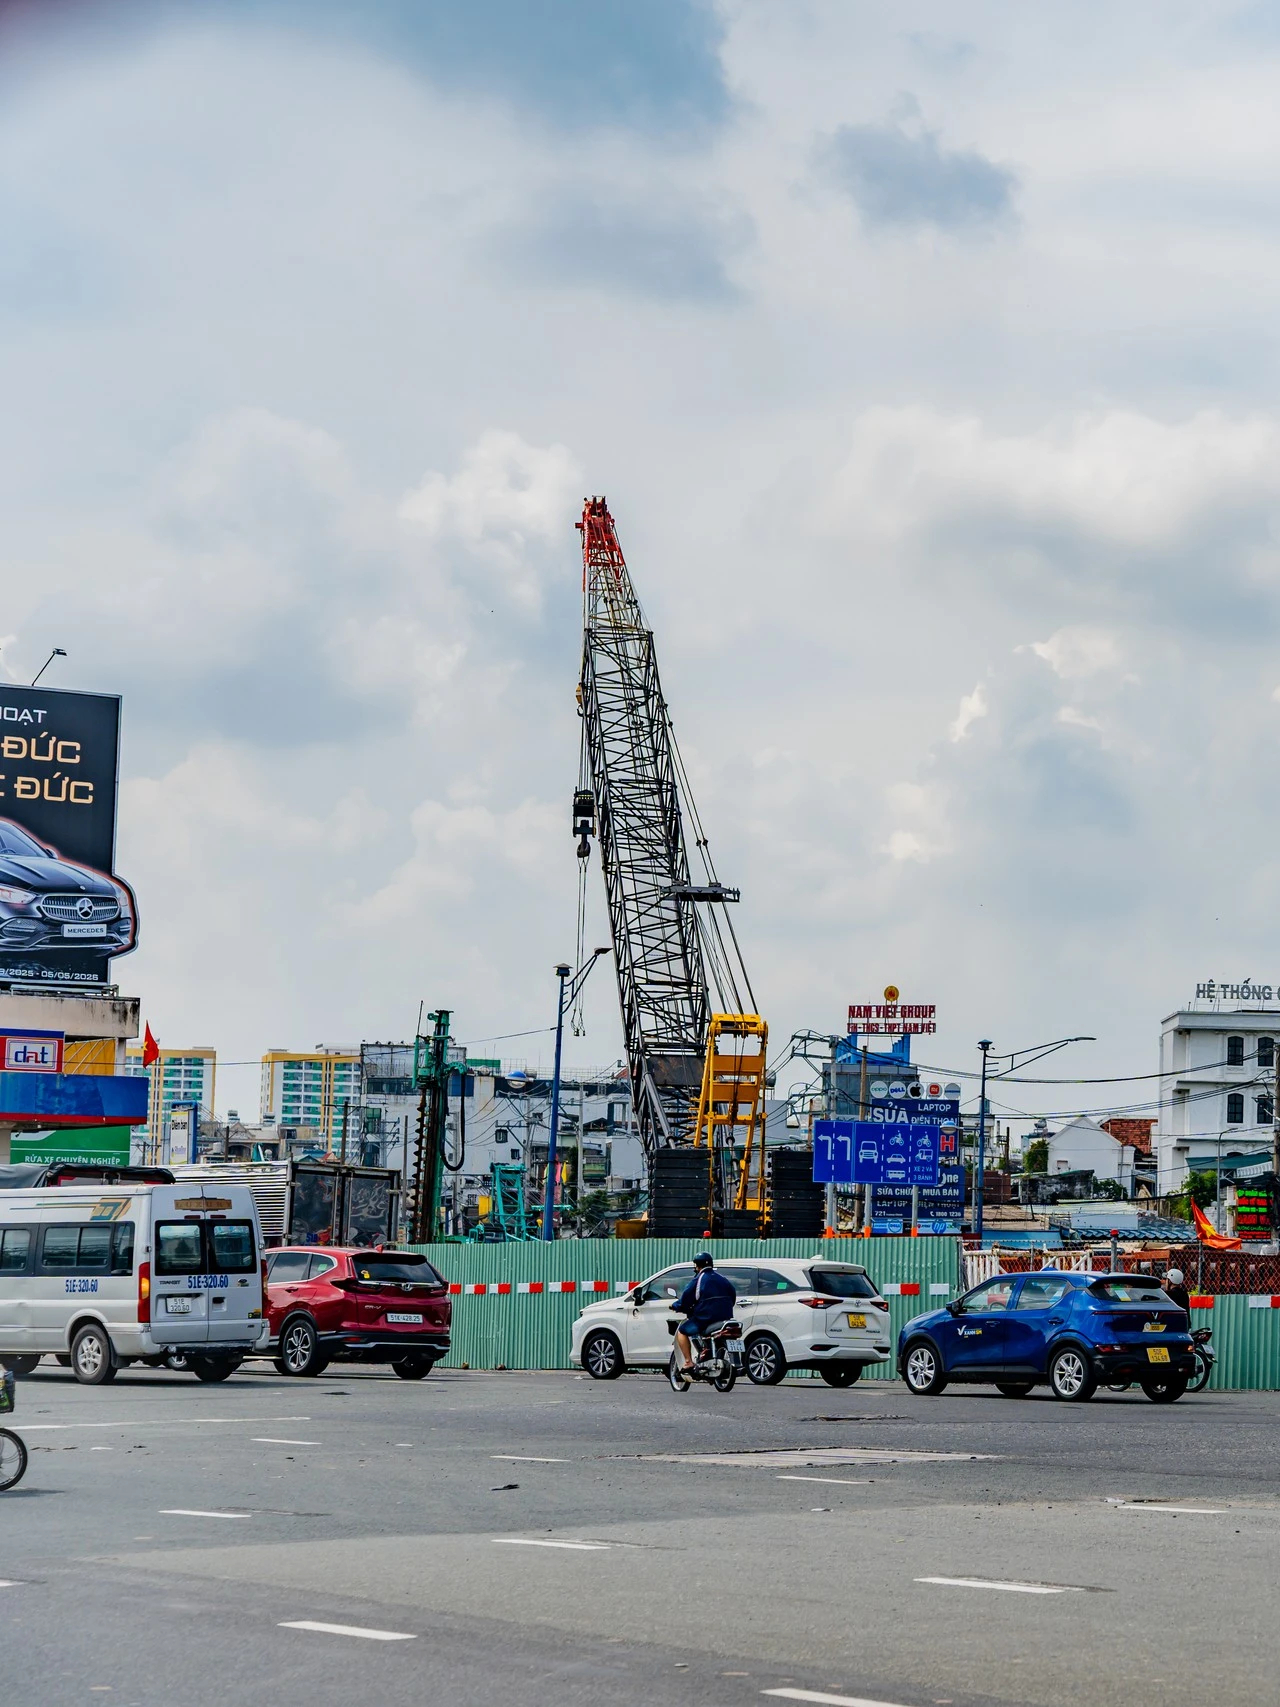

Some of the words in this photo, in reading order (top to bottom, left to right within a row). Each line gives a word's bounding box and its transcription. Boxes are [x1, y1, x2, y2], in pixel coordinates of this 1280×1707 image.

[0, 706, 47, 725] OẠT
[1, 732, 80, 763] ĐỨC
[14, 772, 93, 804] ĐỨC
[1196, 980, 1216, 1002] HỆ
[1221, 978, 1273, 1000] THỐNG
[849, 1006, 872, 1018] NAM
[901, 1006, 935, 1018] GROUP
[941, 1135, 954, 1151] H
[942, 1186, 959, 1196] BÁN
[65, 1279, 98, 1293] 51E-320.60
[188, 1275, 228, 1289] 51E-320.60
